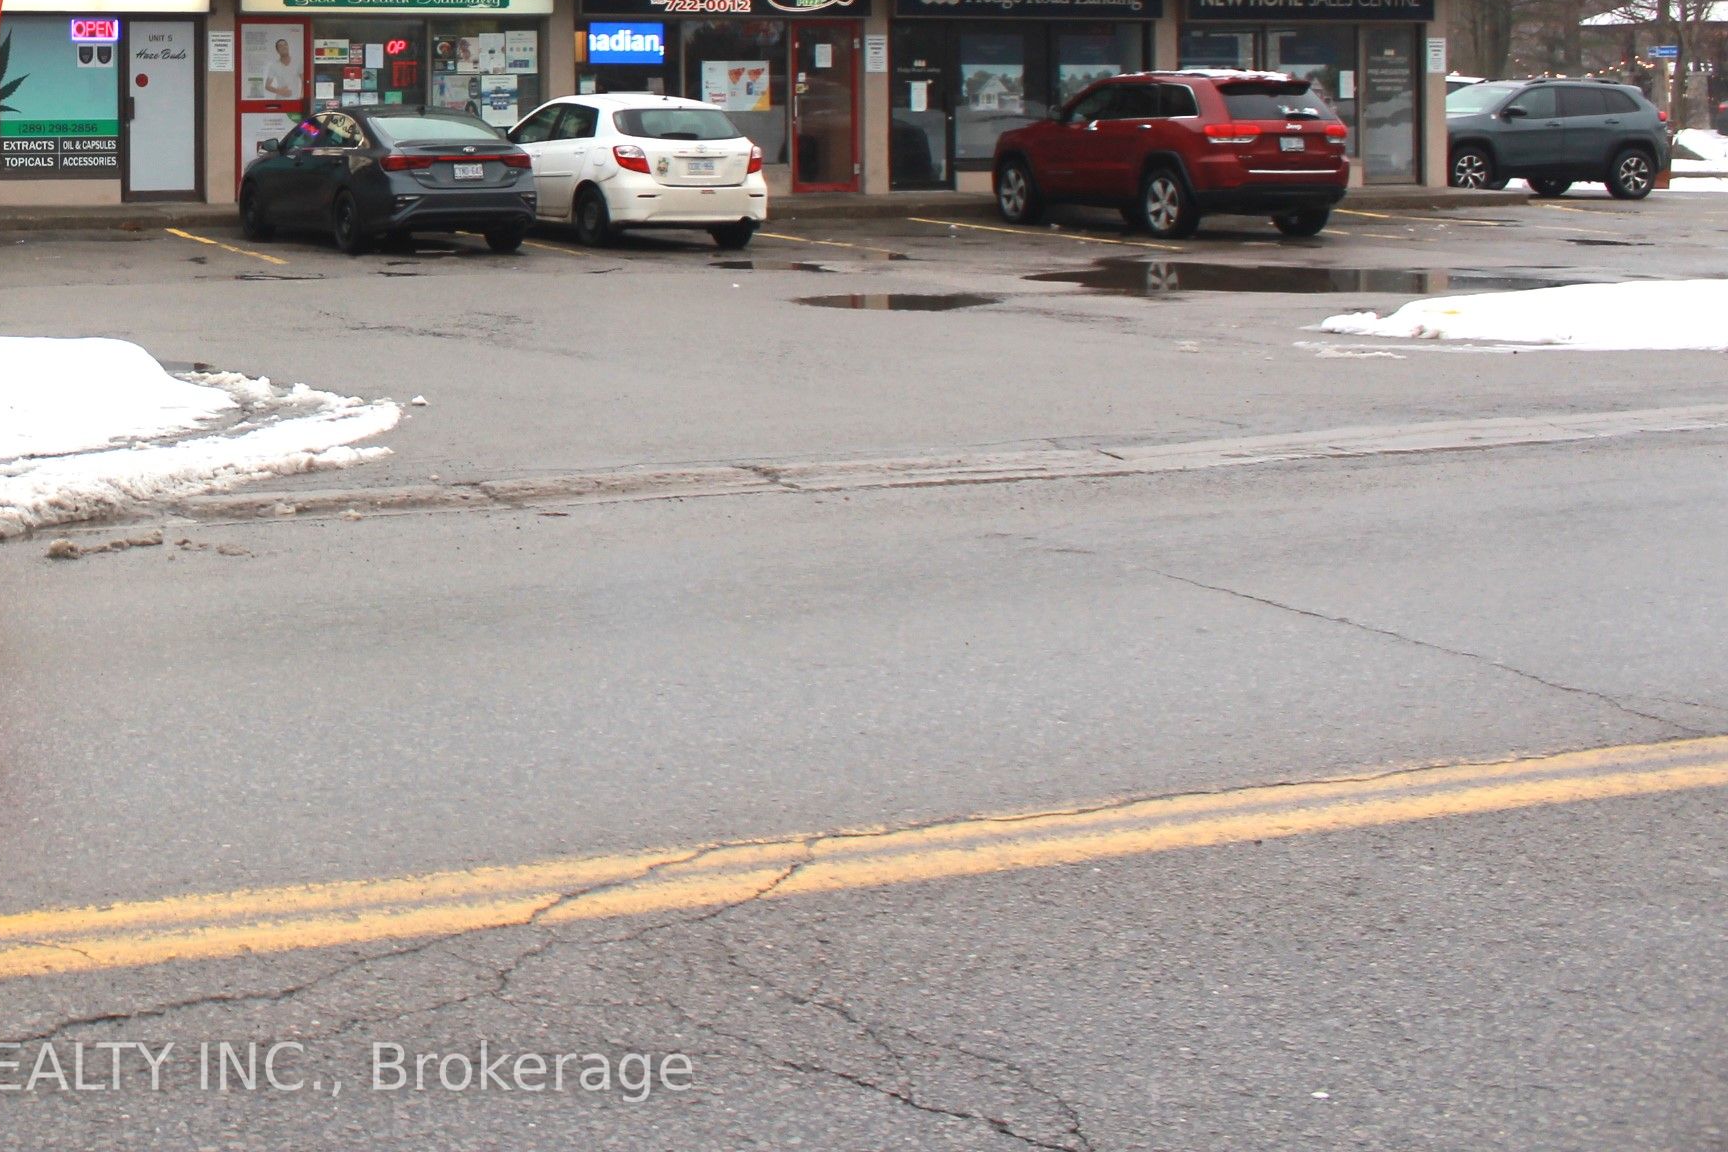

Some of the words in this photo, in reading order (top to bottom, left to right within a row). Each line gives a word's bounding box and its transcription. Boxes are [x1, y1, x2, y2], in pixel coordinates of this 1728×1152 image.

[74, 21, 115, 37] OPEN
[148, 34, 165, 42] UNIT
[160, 48, 186, 60] Buds
[18, 123, 46, 134] (289)
[48, 123, 98, 133] 298-2856
[3, 140, 55, 151] EXTRACTS
[62, 140, 74, 150] OIL
[75, 141, 82, 150] &
[82, 140, 117, 150] CAPSULES
[5, 157, 54, 167] TOPICALS
[62, 156, 117, 166] ACCESSORIES
